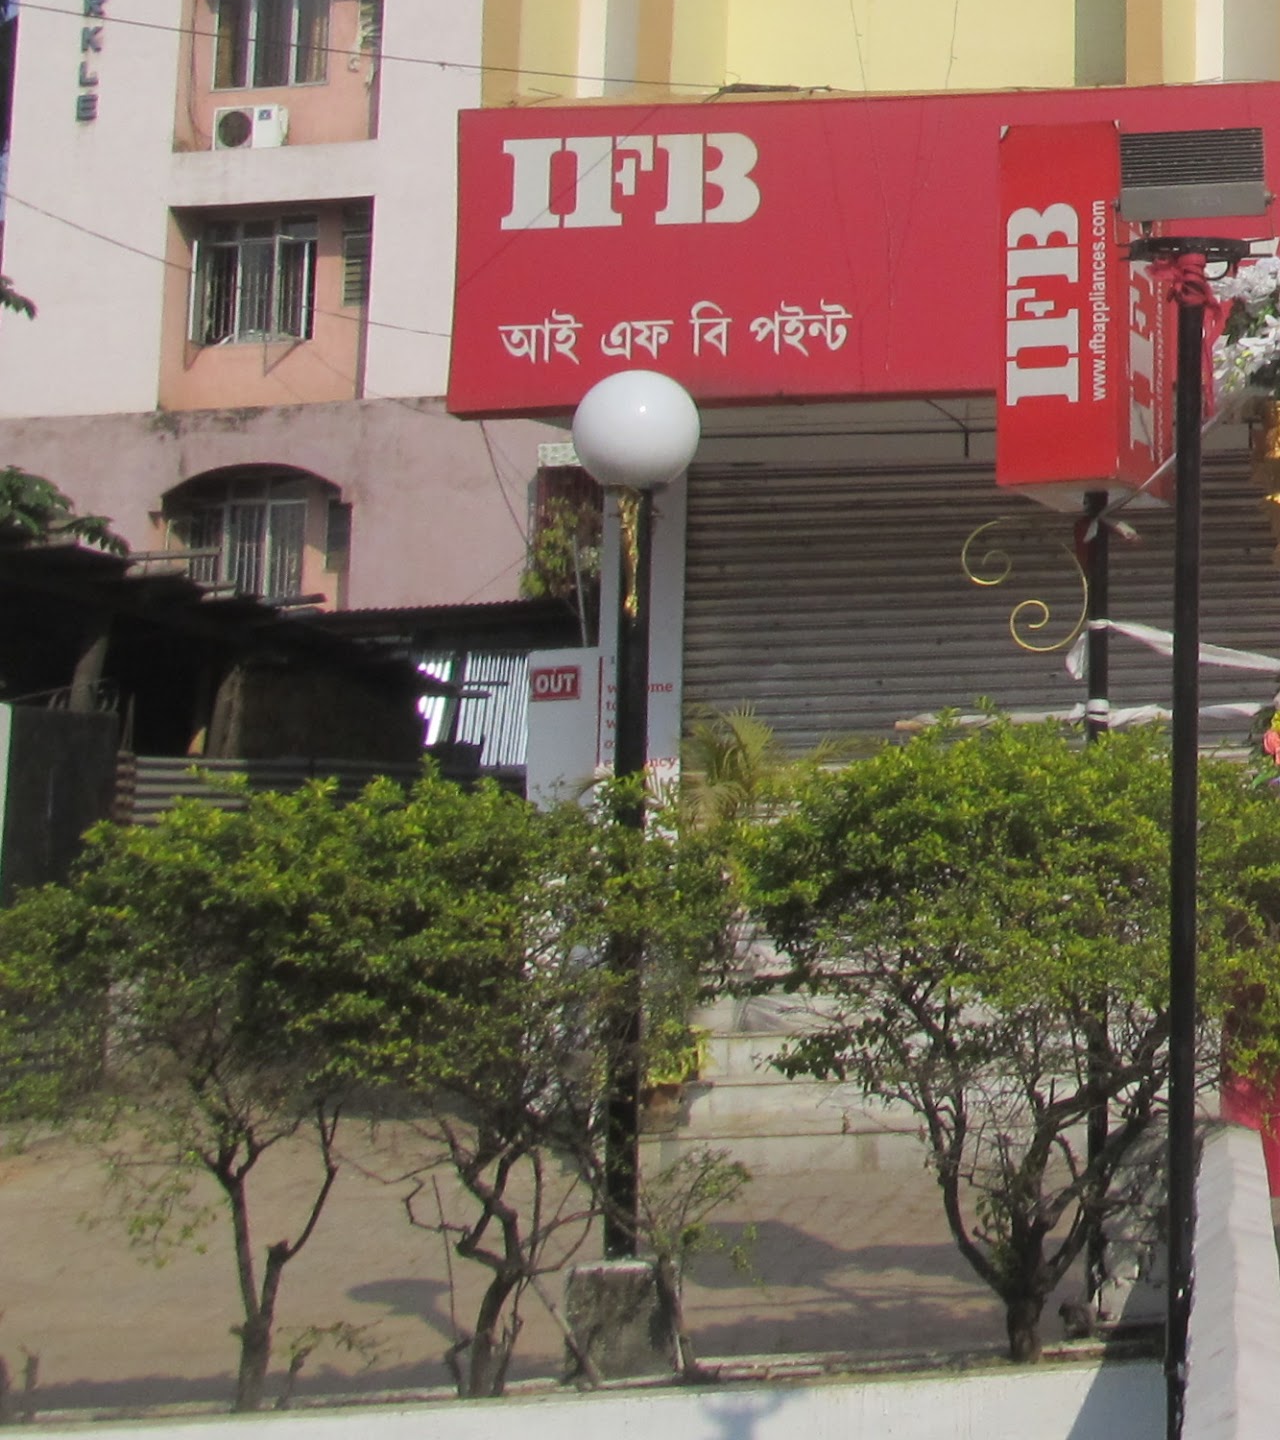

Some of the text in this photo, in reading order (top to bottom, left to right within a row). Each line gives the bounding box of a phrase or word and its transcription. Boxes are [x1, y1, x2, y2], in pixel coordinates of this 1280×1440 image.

[500, 131, 761, 231] IFB
[498, 298, 853, 366] আই এফ বি পইন্ট
[1006, 202, 1080, 407] IFB
[1088, 199, 1110, 402] www.ifbappliances.com
[535, 674, 575, 693] OUT
